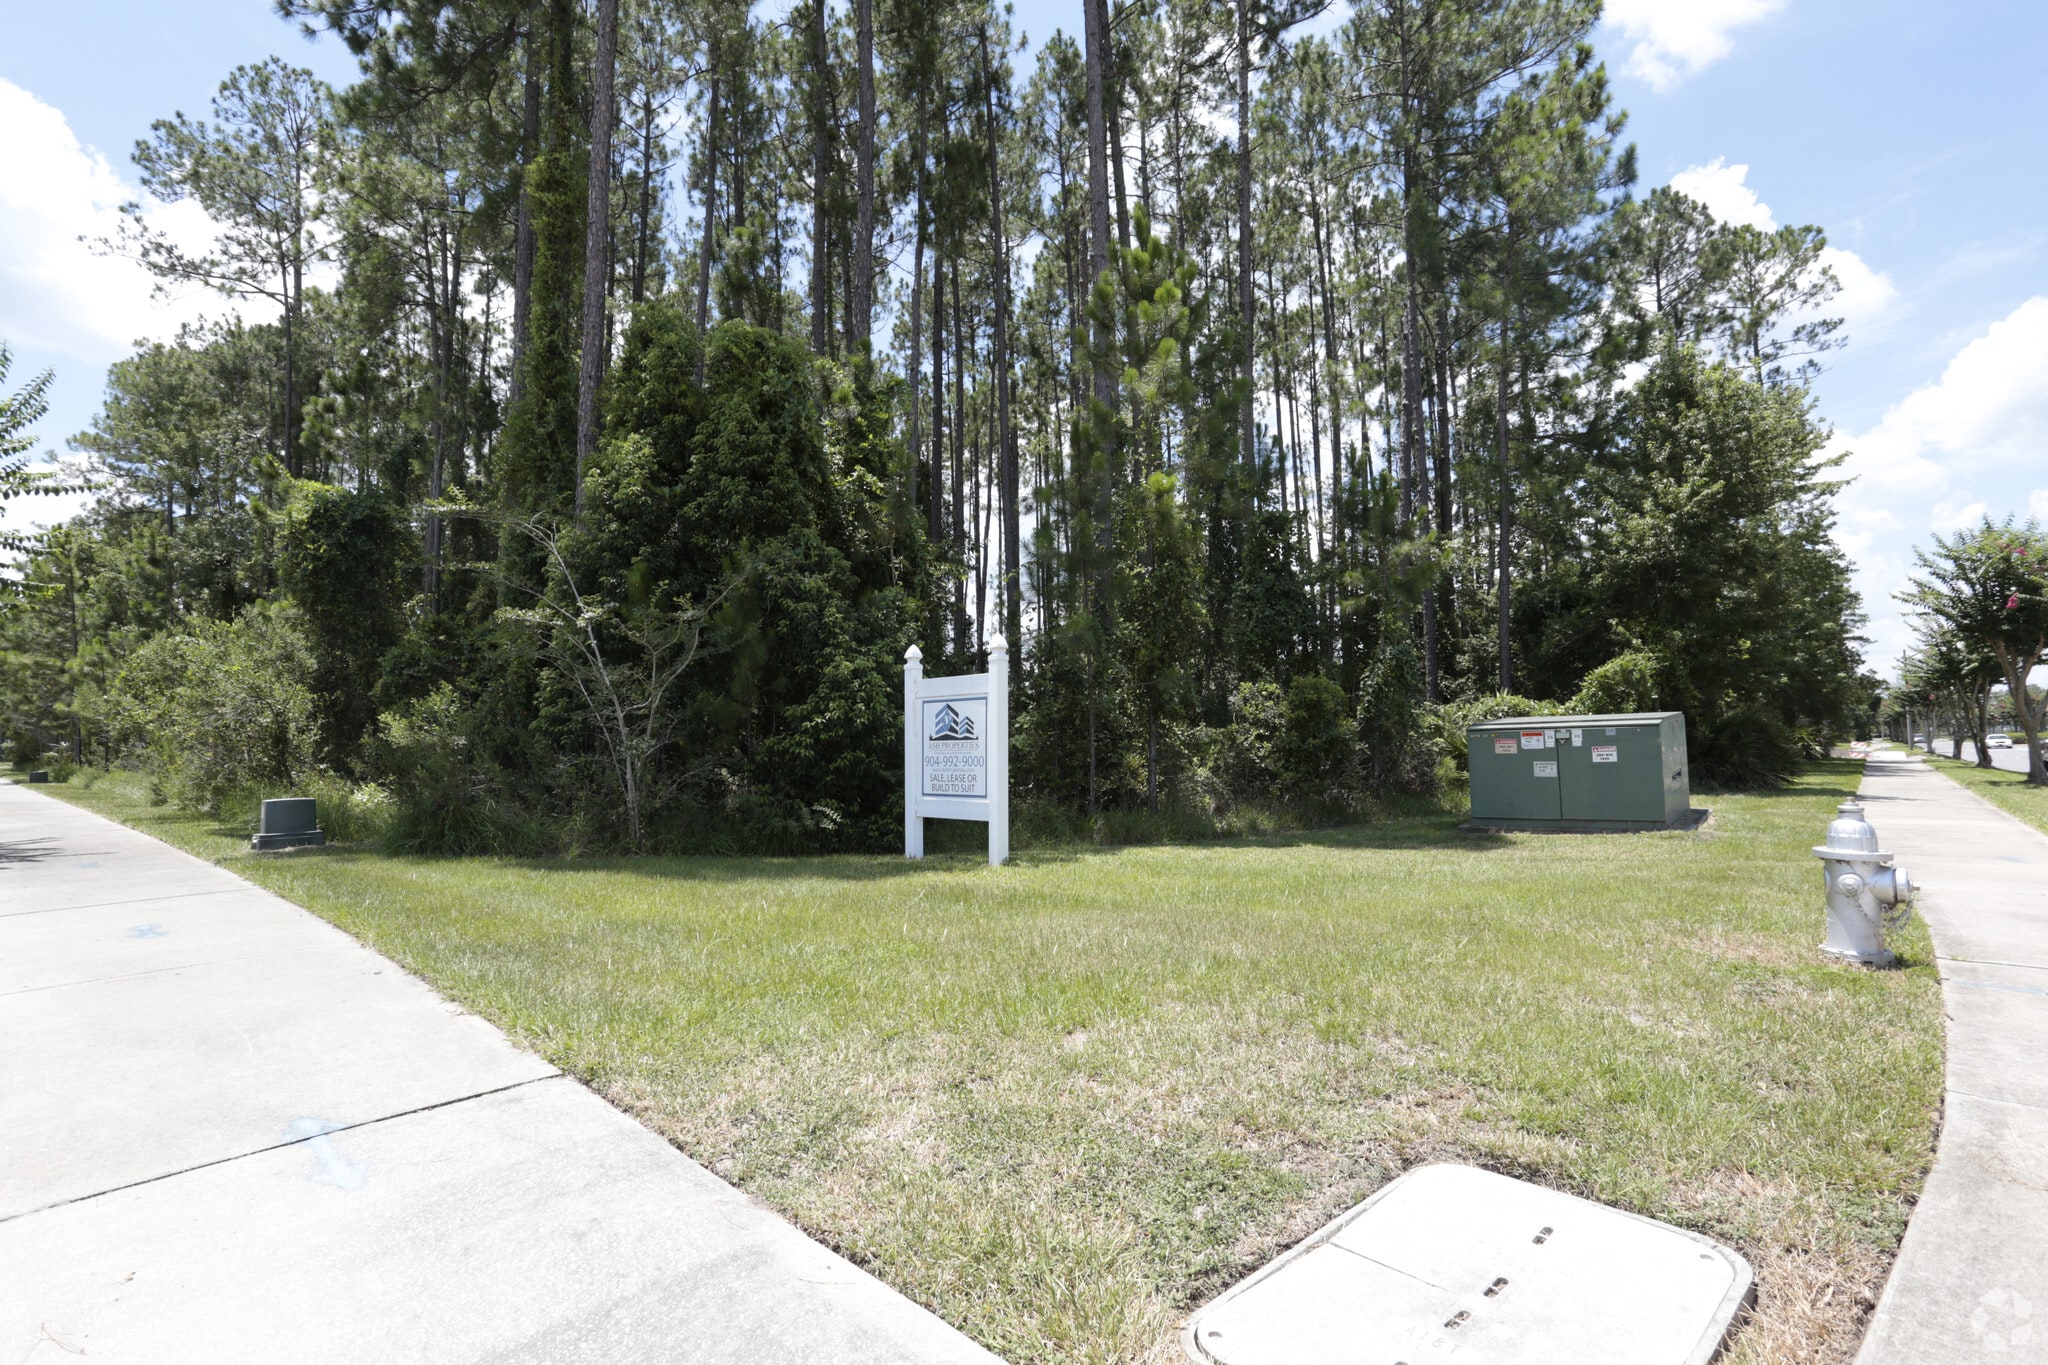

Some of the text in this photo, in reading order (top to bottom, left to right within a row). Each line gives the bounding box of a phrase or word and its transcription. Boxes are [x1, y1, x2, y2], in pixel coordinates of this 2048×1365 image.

[929, 741, 979, 750] ASH PROPERTIES
[925, 755, 984, 767] 904-992-9000
[947, 773, 966, 783] LEASE
[967, 773, 977, 783] OR
[932, 783, 975, 793] BUILD TO SUIT
